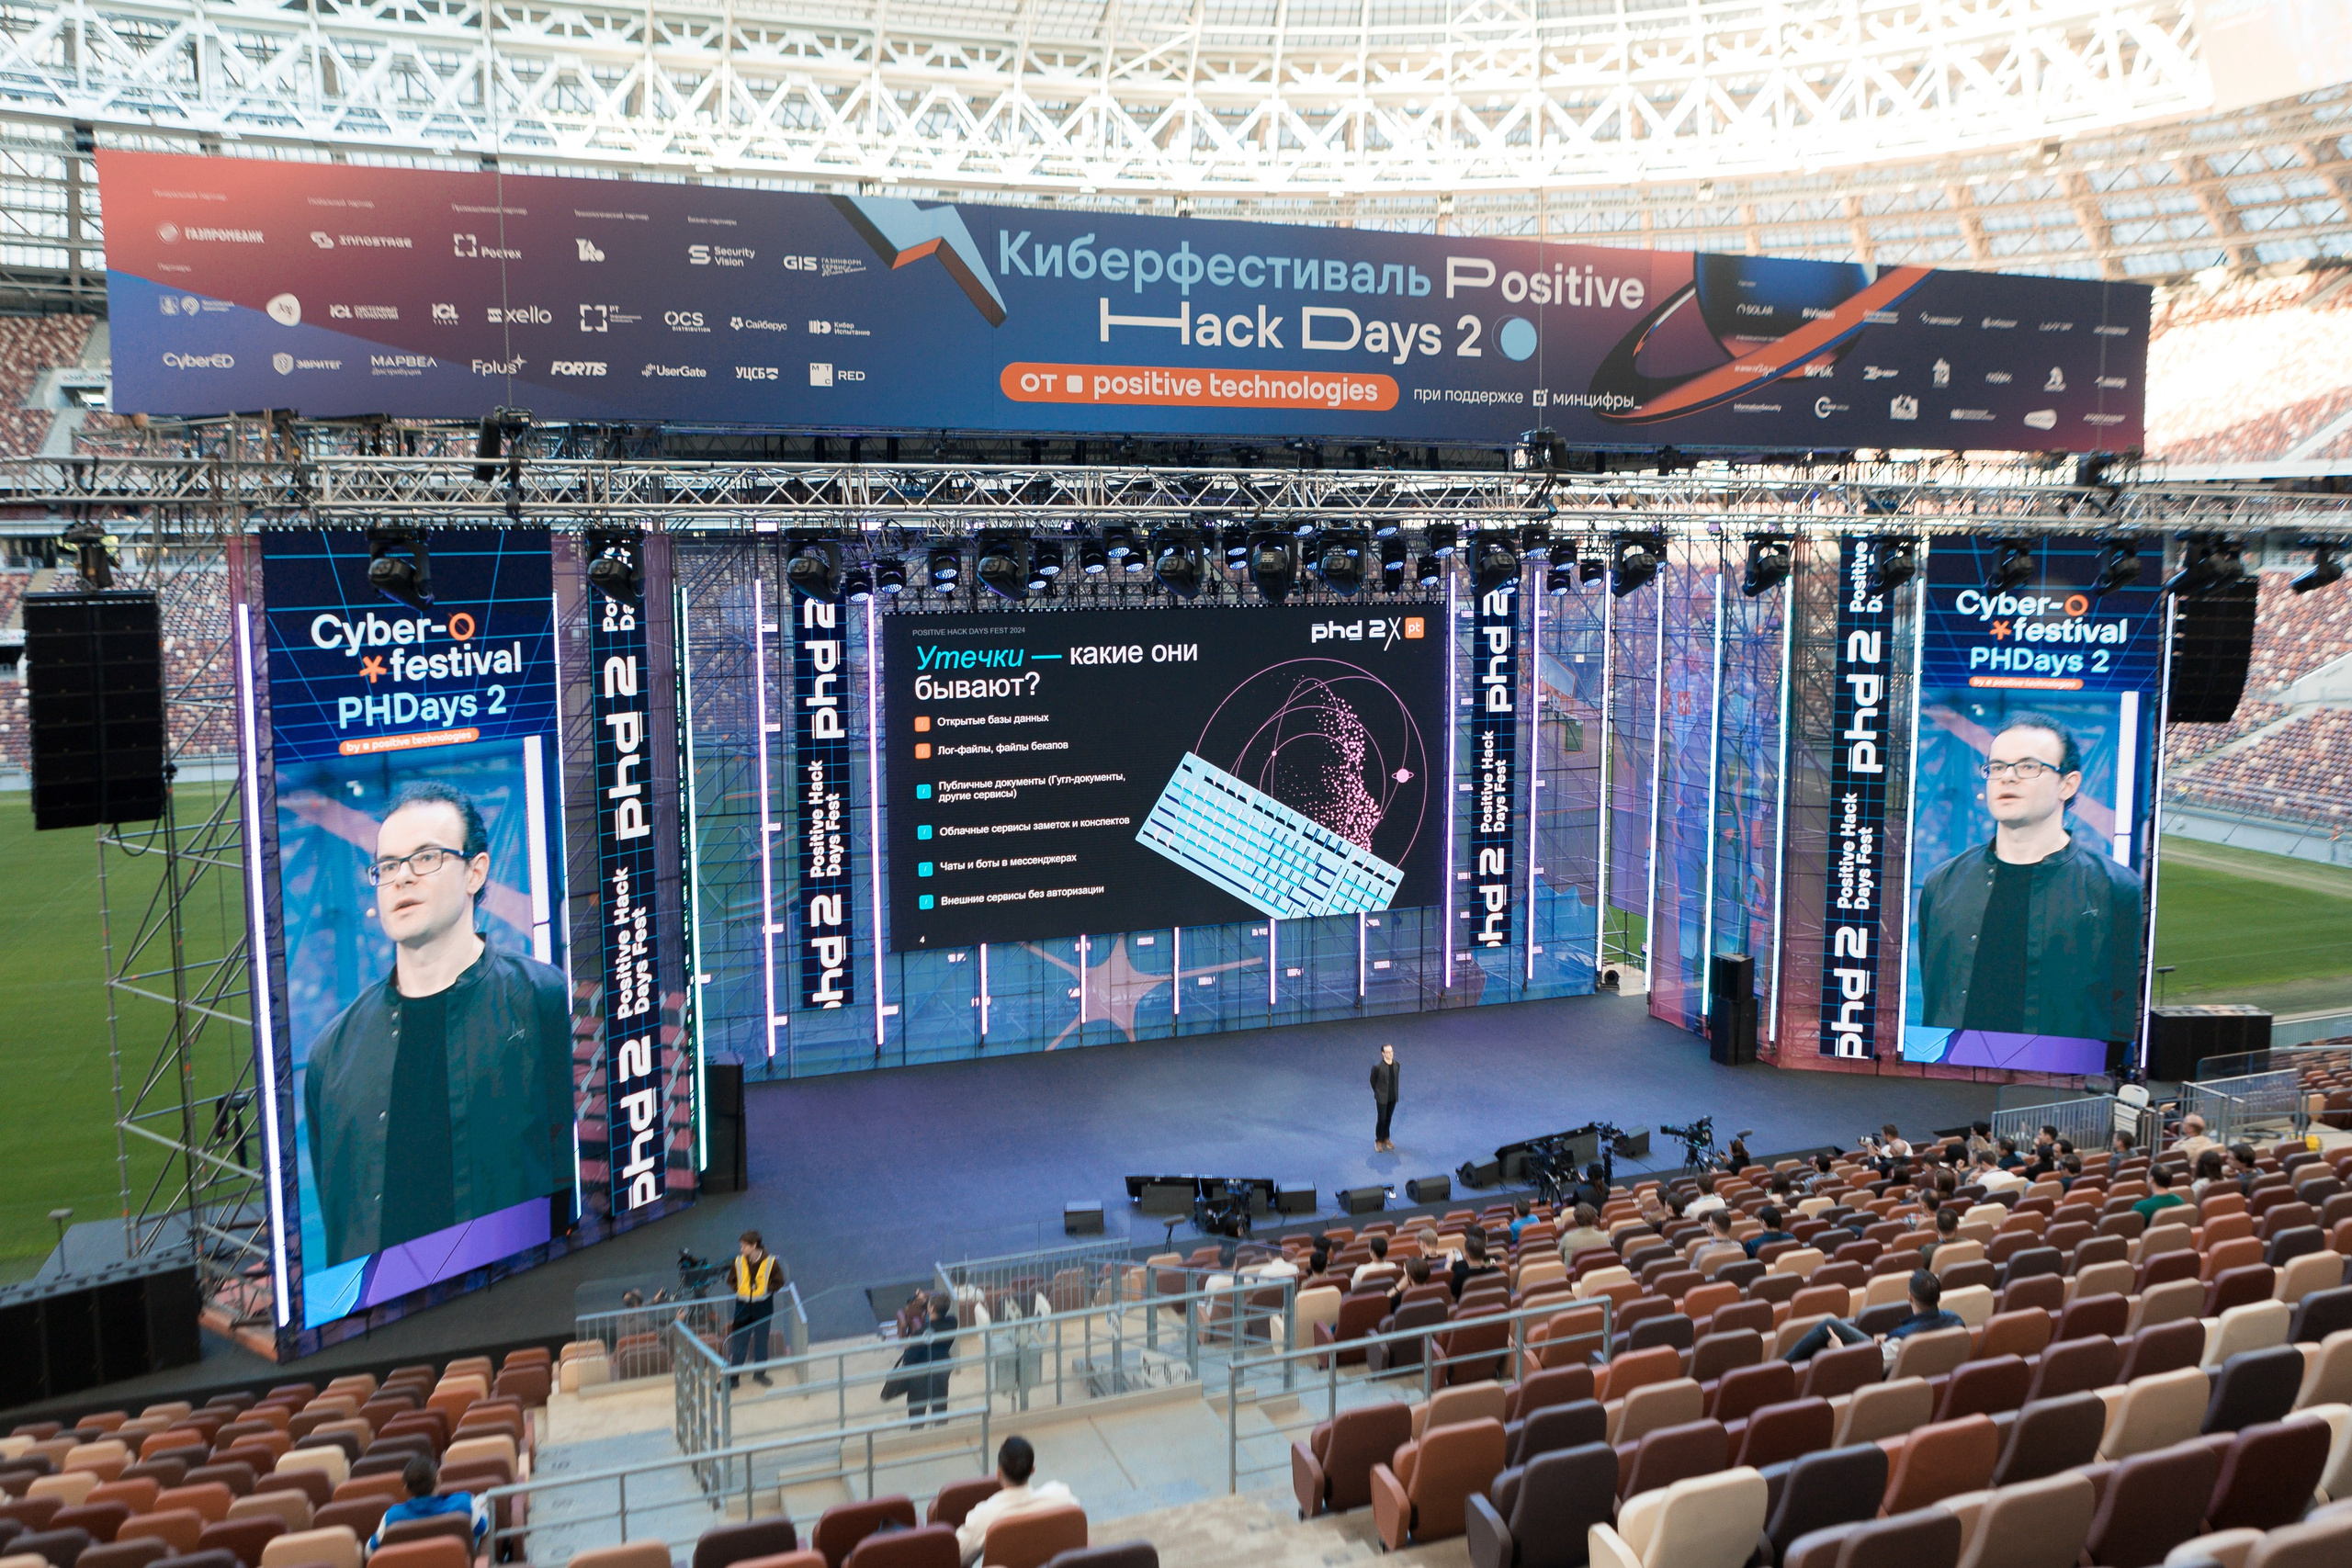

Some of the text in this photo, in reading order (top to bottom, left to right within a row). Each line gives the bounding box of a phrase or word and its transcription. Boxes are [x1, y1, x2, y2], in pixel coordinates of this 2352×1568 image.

[714, 245, 755, 259] Security
[715, 256, 744, 267] Vision
[783, 255, 818, 271] GIS
[999, 230, 1431, 297] Киберфестиваль
[1445, 255, 1645, 310] Positive
[505, 305, 552, 324] xello
[664, 310, 704, 327] OCS
[745, 319, 787, 332] Сайберус
[1100, 297, 1483, 365] Hack Days 2
[163, 352, 234, 370] CyberED
[551, 360, 608, 377] FORTIS
[656, 364, 707, 378] UserGate
[736, 366, 766, 381] УЦСБ
[838, 370, 866, 381] RED
[1094, 371, 1202, 400] positive
[1210, 373, 1378, 407] technologies
[1414, 388, 1442, 404] при
[1444, 388, 1524, 406] поддержке
[1849, 541, 1868, 613] Positive
[1311, 620, 1363, 643] phd
[1369, 619, 1386, 637] 2
[1408, 622, 1421, 635] pt
[917, 646, 1024, 670] Утечки
[1070, 646, 1143, 665] какие
[1151, 643, 1198, 662] они
[1847, 628, 1883, 664] 2
[605, 656, 638, 698] 2
[1482, 626, 1512, 713] phd
[1970, 647, 2110, 678] PHDays 2
[805, 639, 844, 739] phd
[915, 671, 1040, 700] бывают?
[338, 684, 507, 729] PHDays 2
[937, 713, 1049, 728] Открытые базы данных
[1843, 673, 1883, 774] phd
[346, 730, 472, 753] by positive technologies
[938, 740, 1069, 756] Лог-файлы, файлы бекапов
[605, 711, 650, 841] phd
[939, 773, 1125, 791] Публичные документы (Гугл-документы,
[1480, 730, 1495, 833] Positive Hack
[938, 789, 1017, 803] другие сервисы)
[1493, 759, 1507, 833] Days Fest
[808, 759, 826, 879] Positive Hack
[939, 825, 989, 836] Облачные
[991, 823, 1031, 834] сервисы
[1033, 821, 1070, 829] заметок
[1080, 817, 1130, 828] конспектов
[825, 793, 842, 877] Days Fest
[940, 862, 965, 872] Чаты
[976, 858, 1000, 869] боты
[1001, 859, 1008, 867] в
[1010, 854, 1077, 866] мессенджерах
[1480, 847, 1505, 875] 2
[1838, 791, 1858, 909] Positive Hack
[1854, 826, 1872, 910] Days Fest
[941, 886, 1104, 906] Внешние сервисы без авторизации
[810, 894, 842, 929] 2
[612, 866, 632, 1020] Positive Hack
[920, 935, 925, 944] 4
[1834, 925, 1869, 959] 2
[631, 906, 651, 1015] Days Fest
[618, 1034, 662, 1211] phd 2
